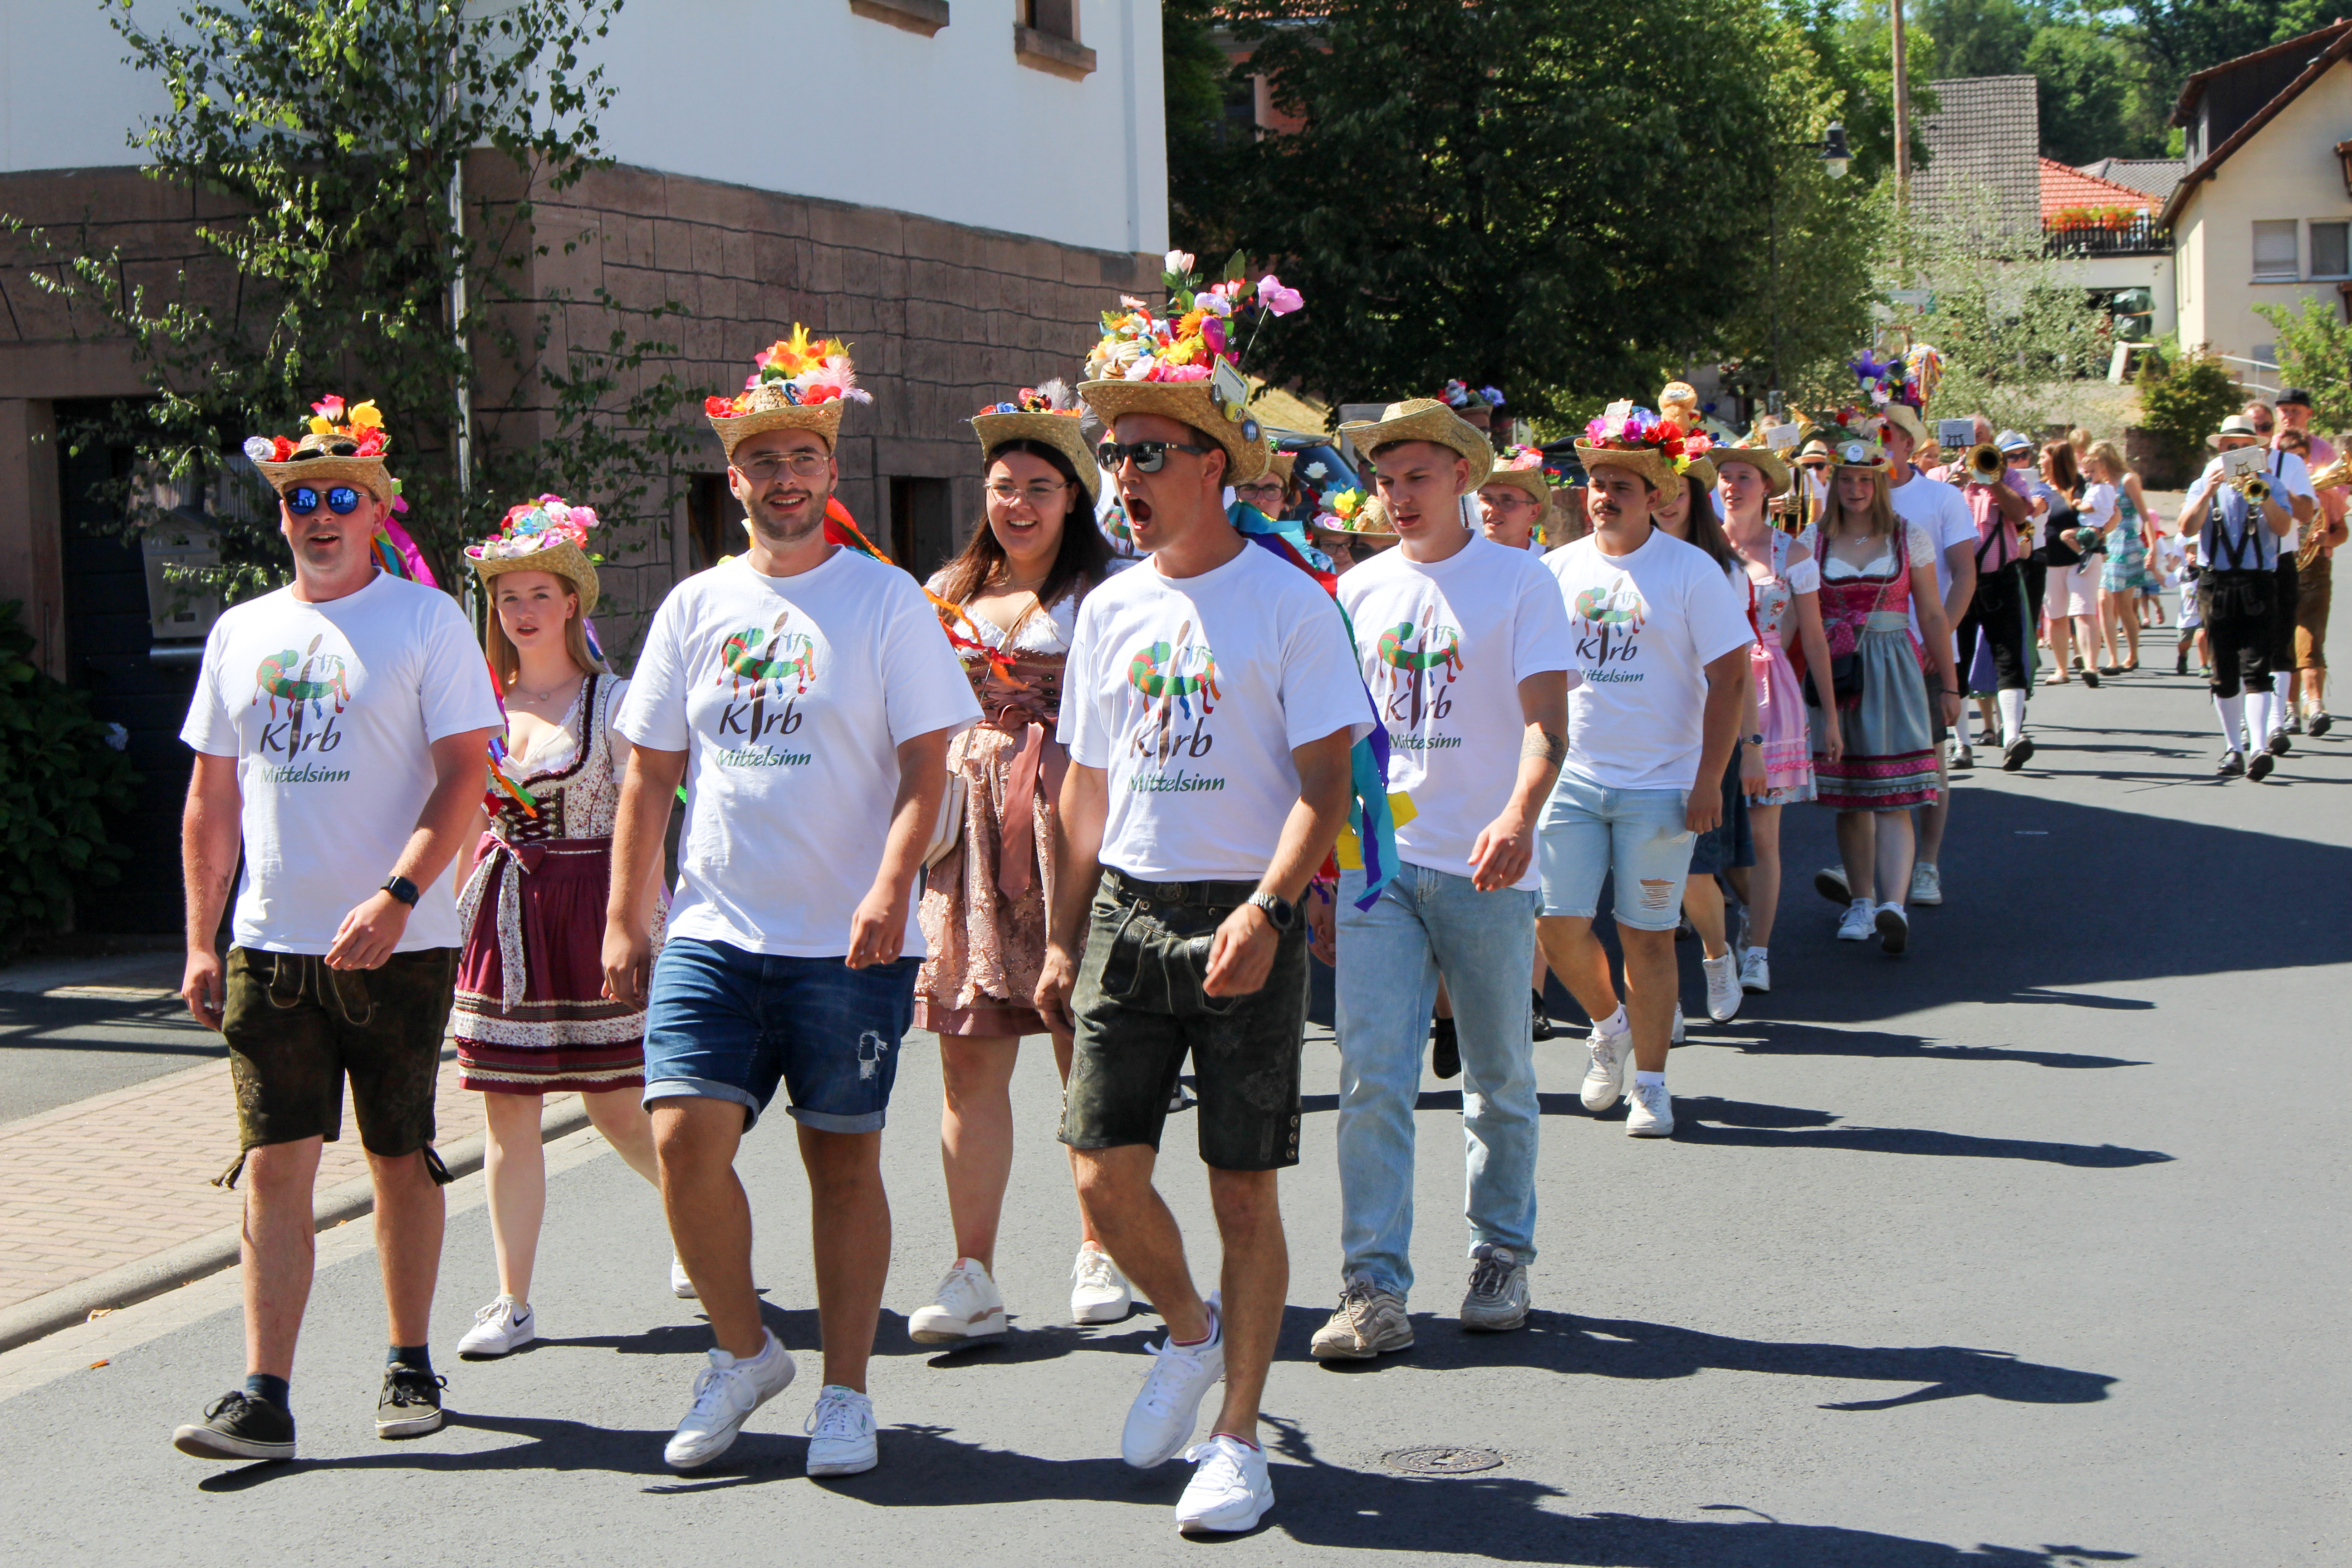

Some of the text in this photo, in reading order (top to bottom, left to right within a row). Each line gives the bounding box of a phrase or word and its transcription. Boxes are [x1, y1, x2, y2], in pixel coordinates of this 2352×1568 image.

[1389, 730, 1461, 750] Mittelsinn
[716, 745, 811, 766] Mittelsinn
[260, 762, 350, 784] Mittelsinn
[1127, 769, 1225, 792] Mittelsinn
